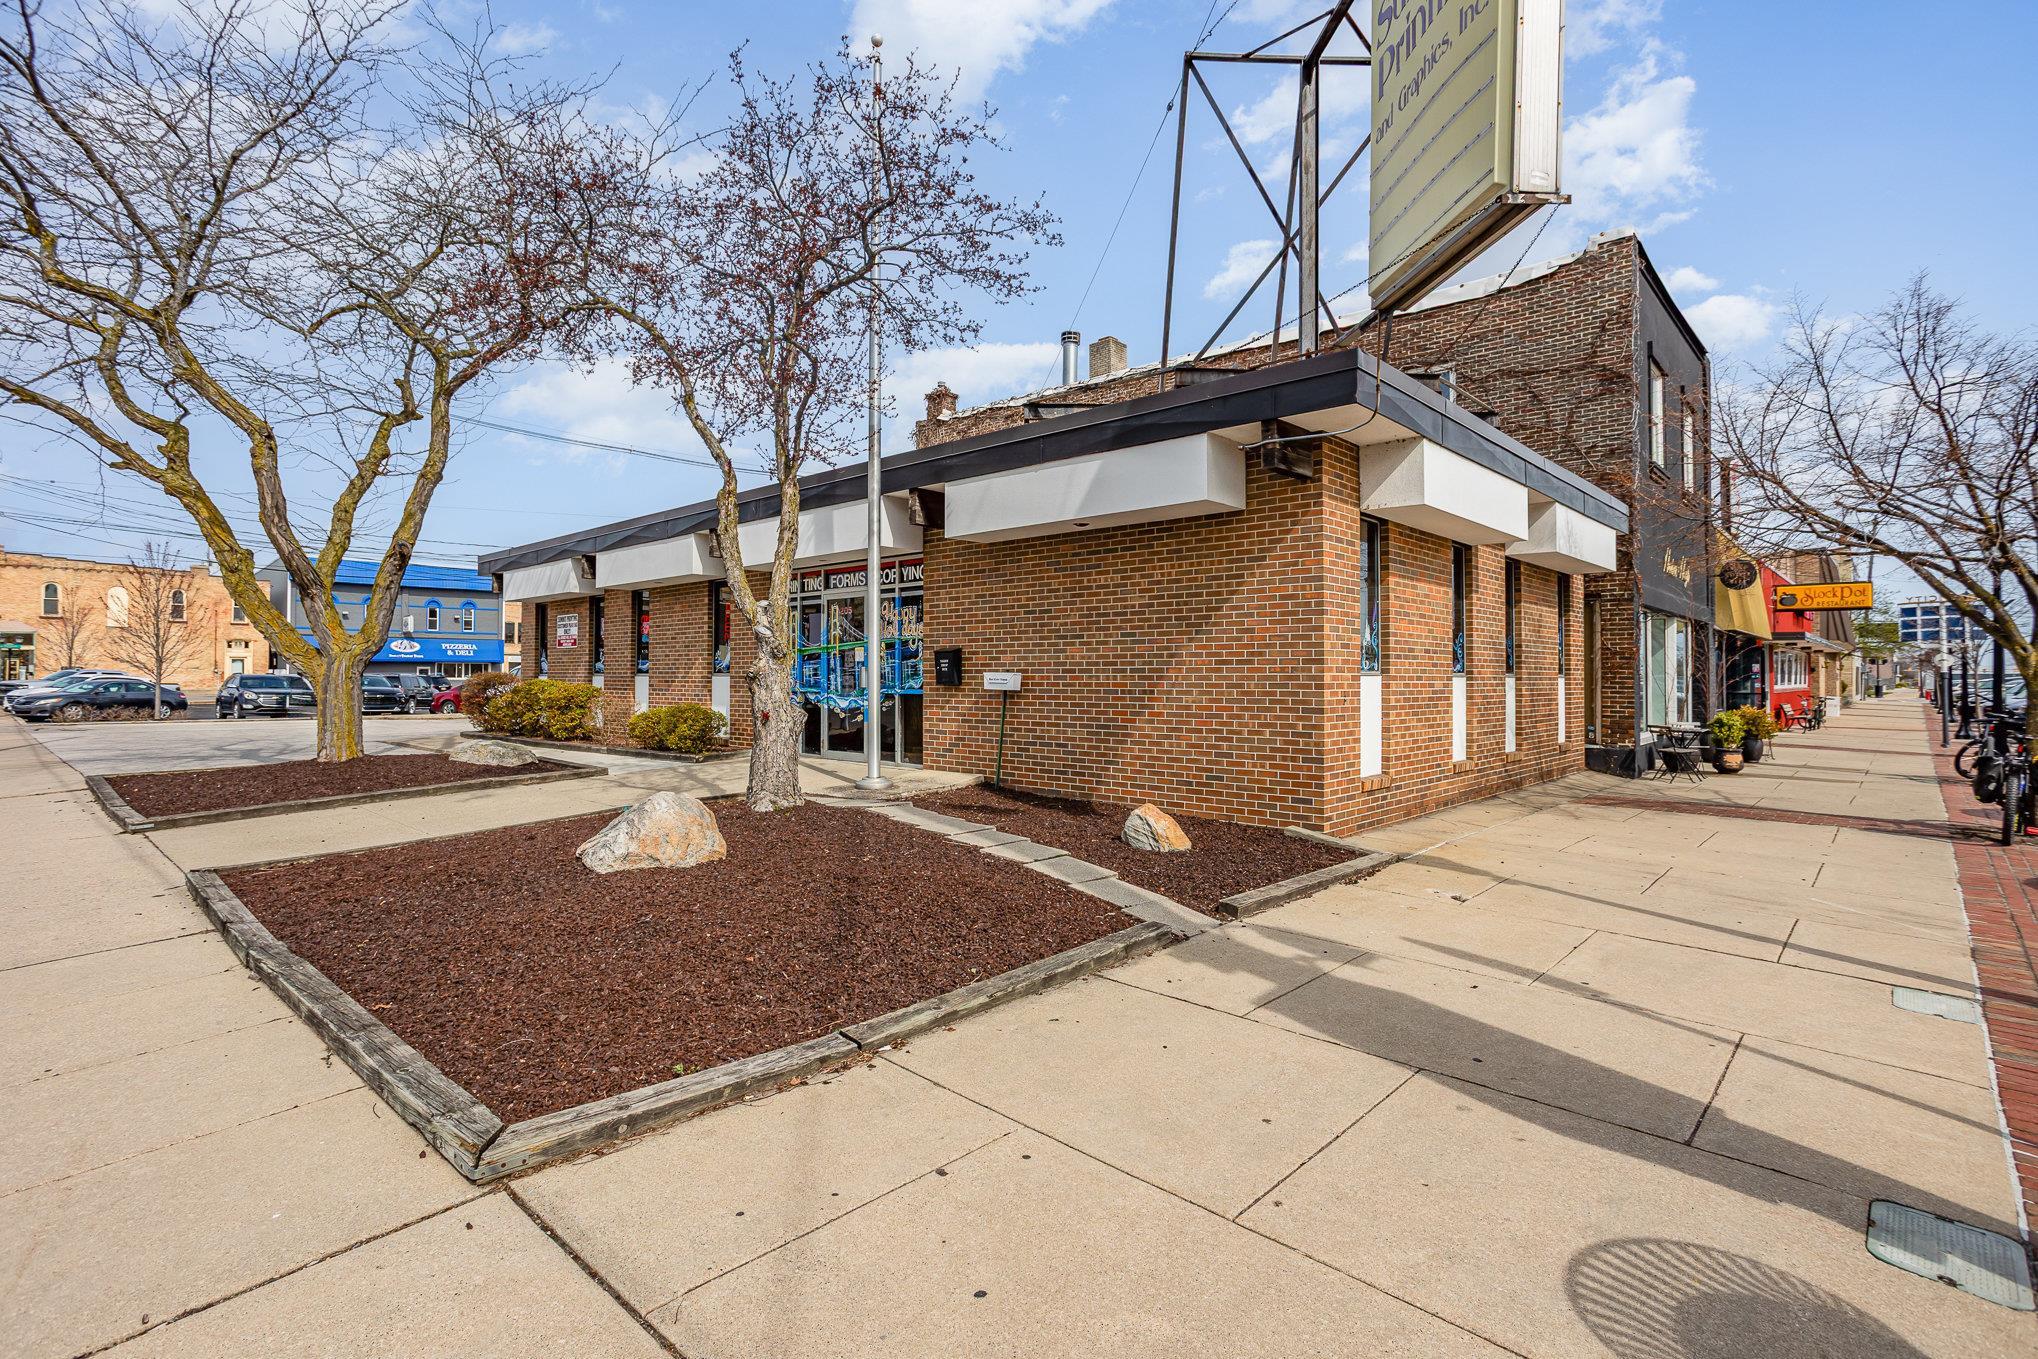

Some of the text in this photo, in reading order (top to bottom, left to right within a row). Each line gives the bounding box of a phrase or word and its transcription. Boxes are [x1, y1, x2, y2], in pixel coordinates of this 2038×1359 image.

[1376, 102, 1394, 144] and
[1398, 32, 1453, 111] Graphics,
[830, 572, 866, 588] FORMS
[1800, 585, 1869, 606] Stock Pot
[1816, 599, 1866, 607] RESTAURANT
